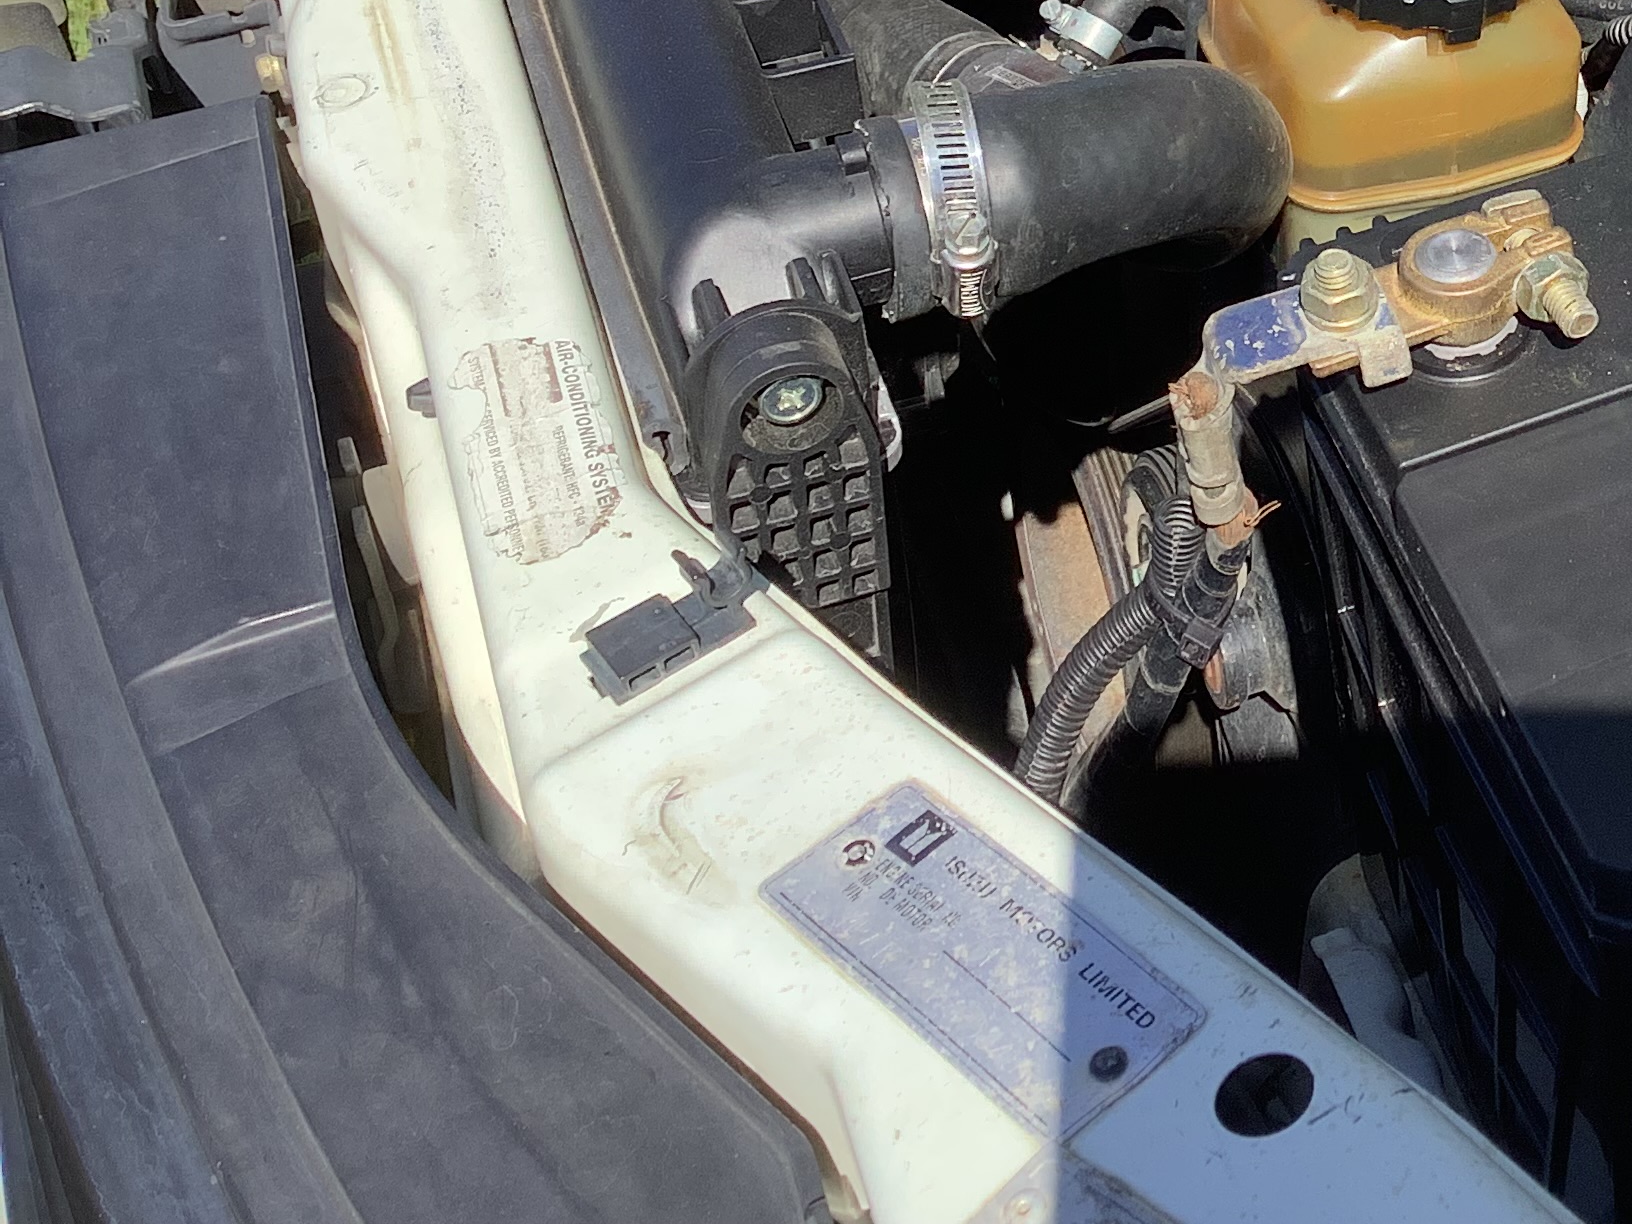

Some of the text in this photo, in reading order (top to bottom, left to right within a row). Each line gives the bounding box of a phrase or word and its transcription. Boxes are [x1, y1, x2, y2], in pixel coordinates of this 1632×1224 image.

[554, 340, 600, 458] AIR-CONDITIONING
[488, 446, 500, 459] BY
[490, 458, 511, 508] ACCREDITED
[565, 482, 578, 499] HFC
[1077, 961, 1157, 1030] LIMITED
